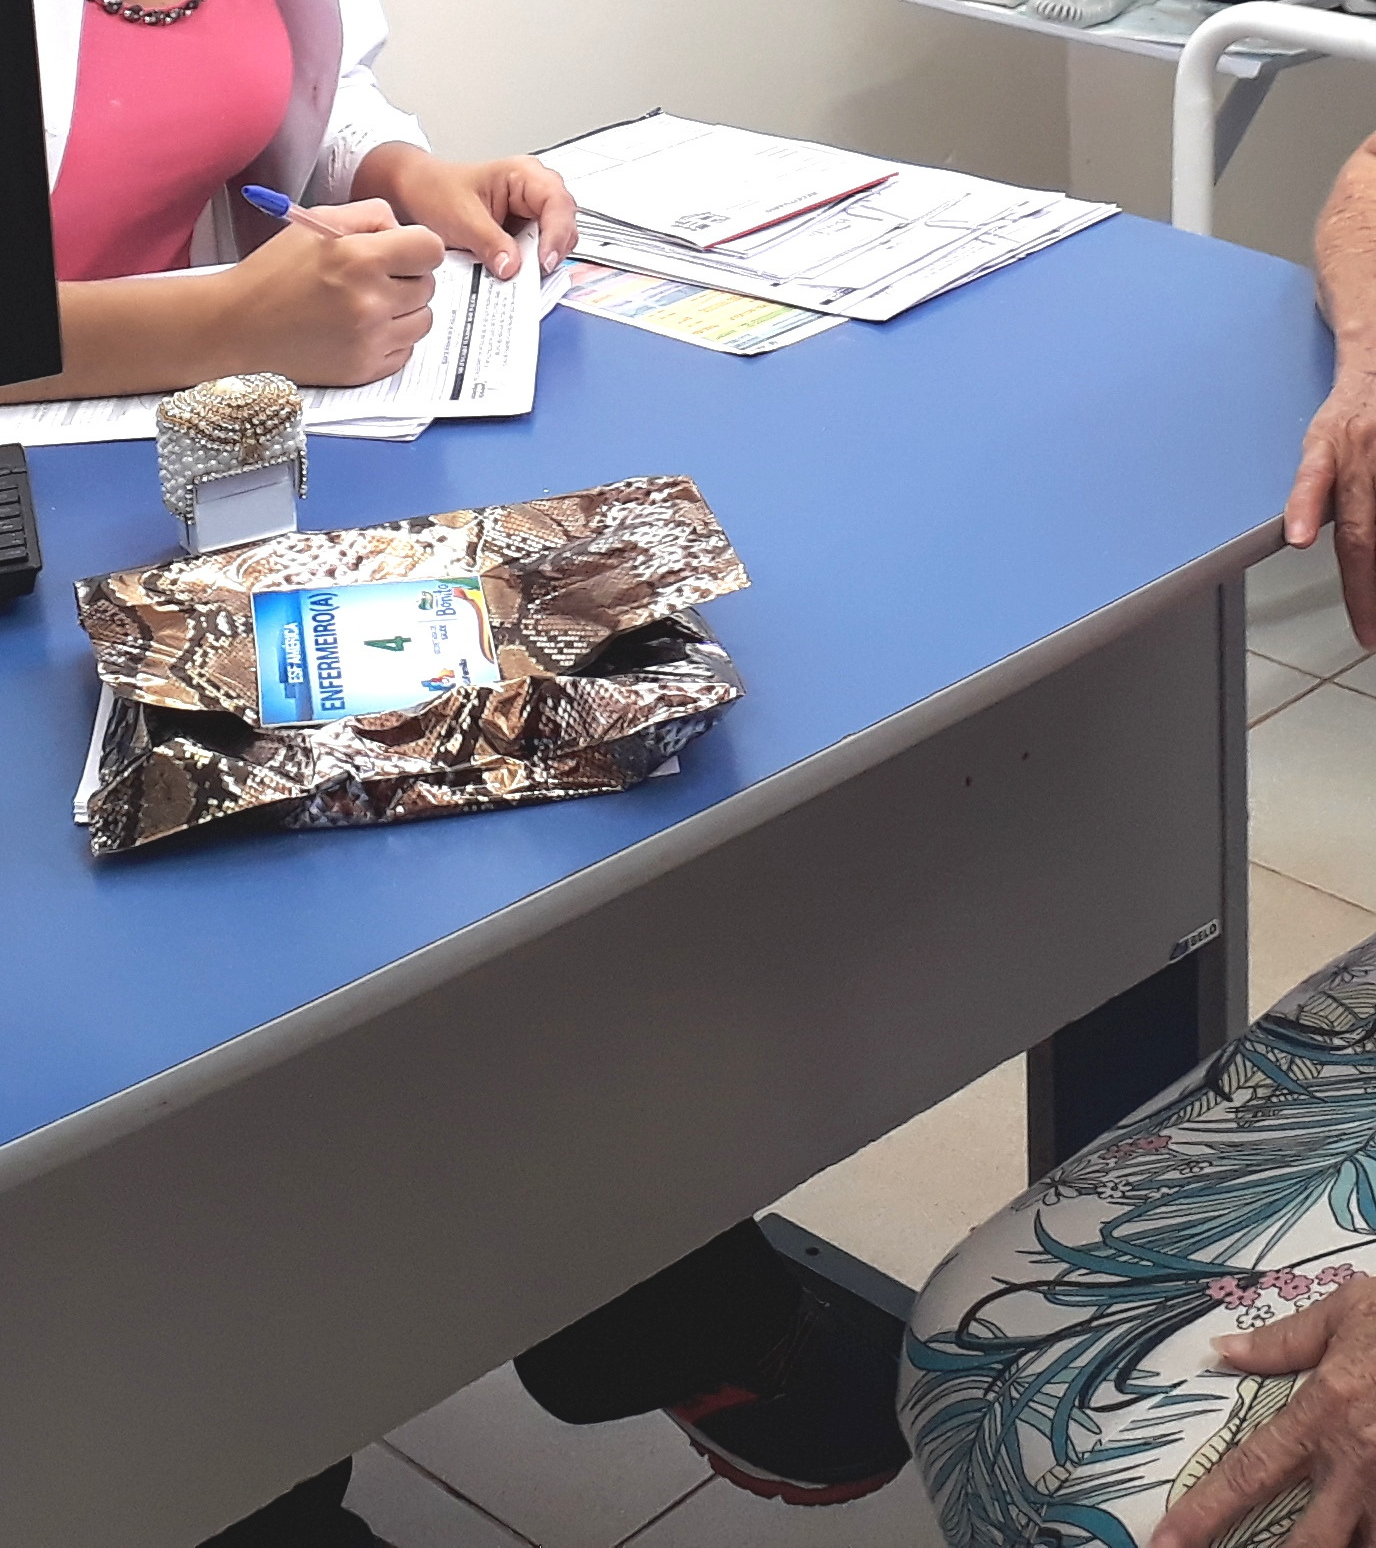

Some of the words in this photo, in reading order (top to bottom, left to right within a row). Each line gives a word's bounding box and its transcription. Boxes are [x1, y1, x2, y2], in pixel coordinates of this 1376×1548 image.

[436, 583, 457, 617] Bonito
[282, 621, 302, 664] AMÉRICA
[309, 592, 346, 711] ENFERMEIRO(A)
[363, 635, 412, 652] 4
[286, 665, 304, 684] ESF
